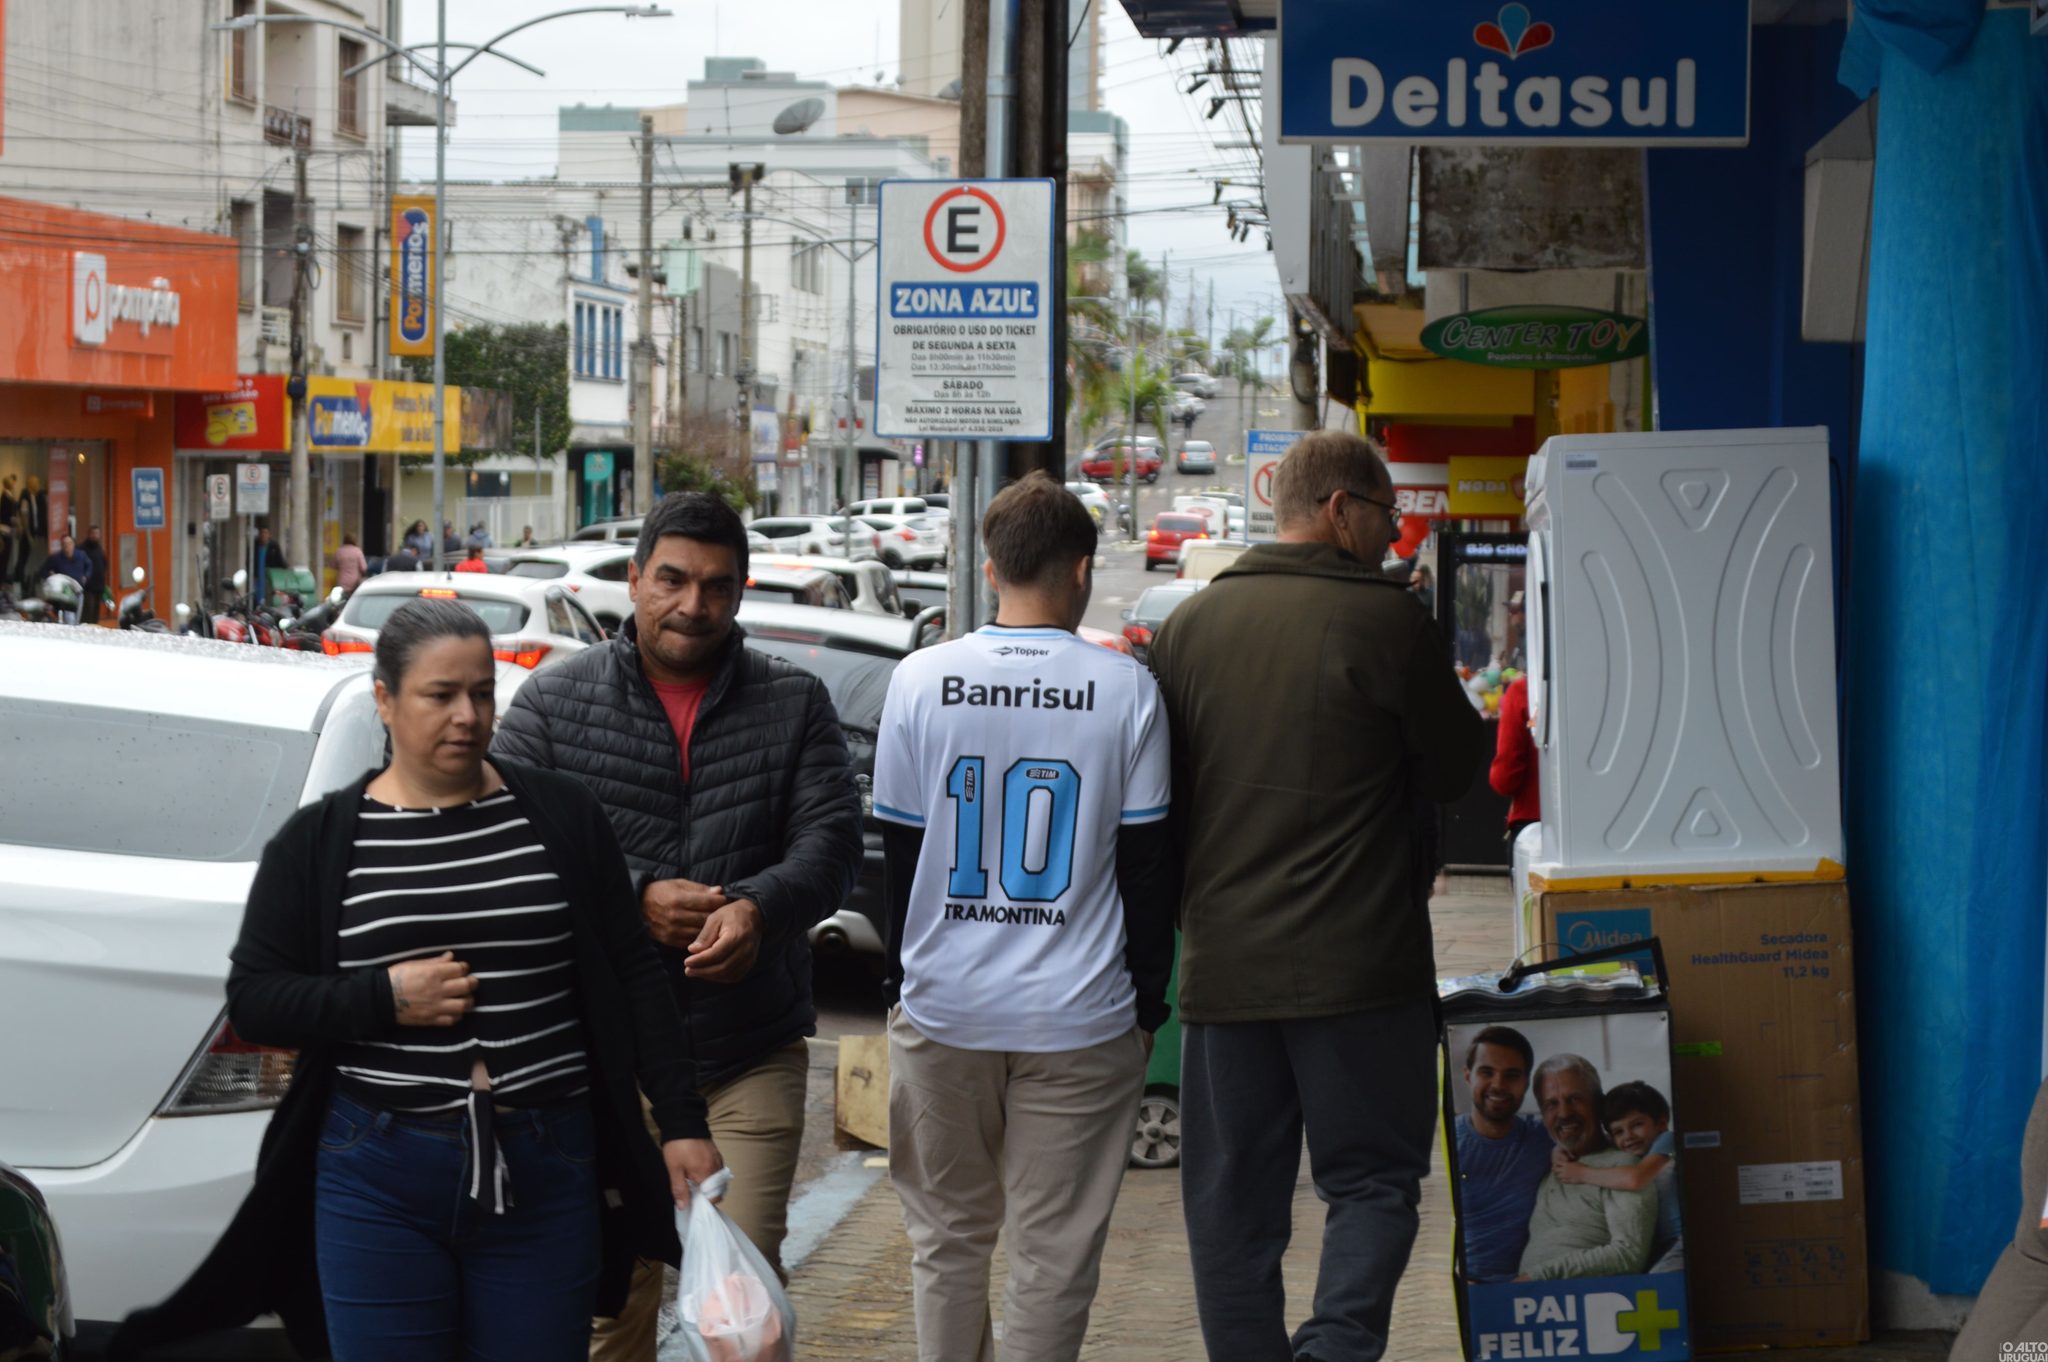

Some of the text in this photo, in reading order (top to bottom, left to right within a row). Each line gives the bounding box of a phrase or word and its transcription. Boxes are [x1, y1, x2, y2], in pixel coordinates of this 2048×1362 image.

[1331, 57, 1696, 128] Deltasul
[947, 207, 980, 252] E
[895, 288, 1035, 312] ZONA AZUL
[893, 323, 1036, 336] OBRIGATÓRIO O USO DO TICKET
[1442, 316, 1643, 352] CENTER TOY
[912, 341, 1016, 350] DE SEGUNDA A SEXTA
[911, 353, 927, 361] Das
[911, 363, 926, 371] Das
[943, 377, 984, 390] SÁBADO
[934, 390, 949, 398] Das
[977, 390, 991, 399] 12h
[905, 404, 1022, 415] MÁXIMO 2 HORAS NA VAGA
[1014, 646, 1051, 657] Topper
[941, 676, 1095, 711] Banrisul
[1041, 769, 1058, 779] TIM
[946, 755, 1082, 903] 10
[944, 902, 1066, 926] TRAMONTINA
[1583, 928, 1643, 947] Midea
[1760, 933, 1828, 946] Secadora
[1691, 949, 1830, 966] HealthGuard Midea
[1811, 965, 1831, 979] kg
[1513, 1295, 1577, 1325] PAI
[1479, 1329, 1581, 1360] FELIZ
